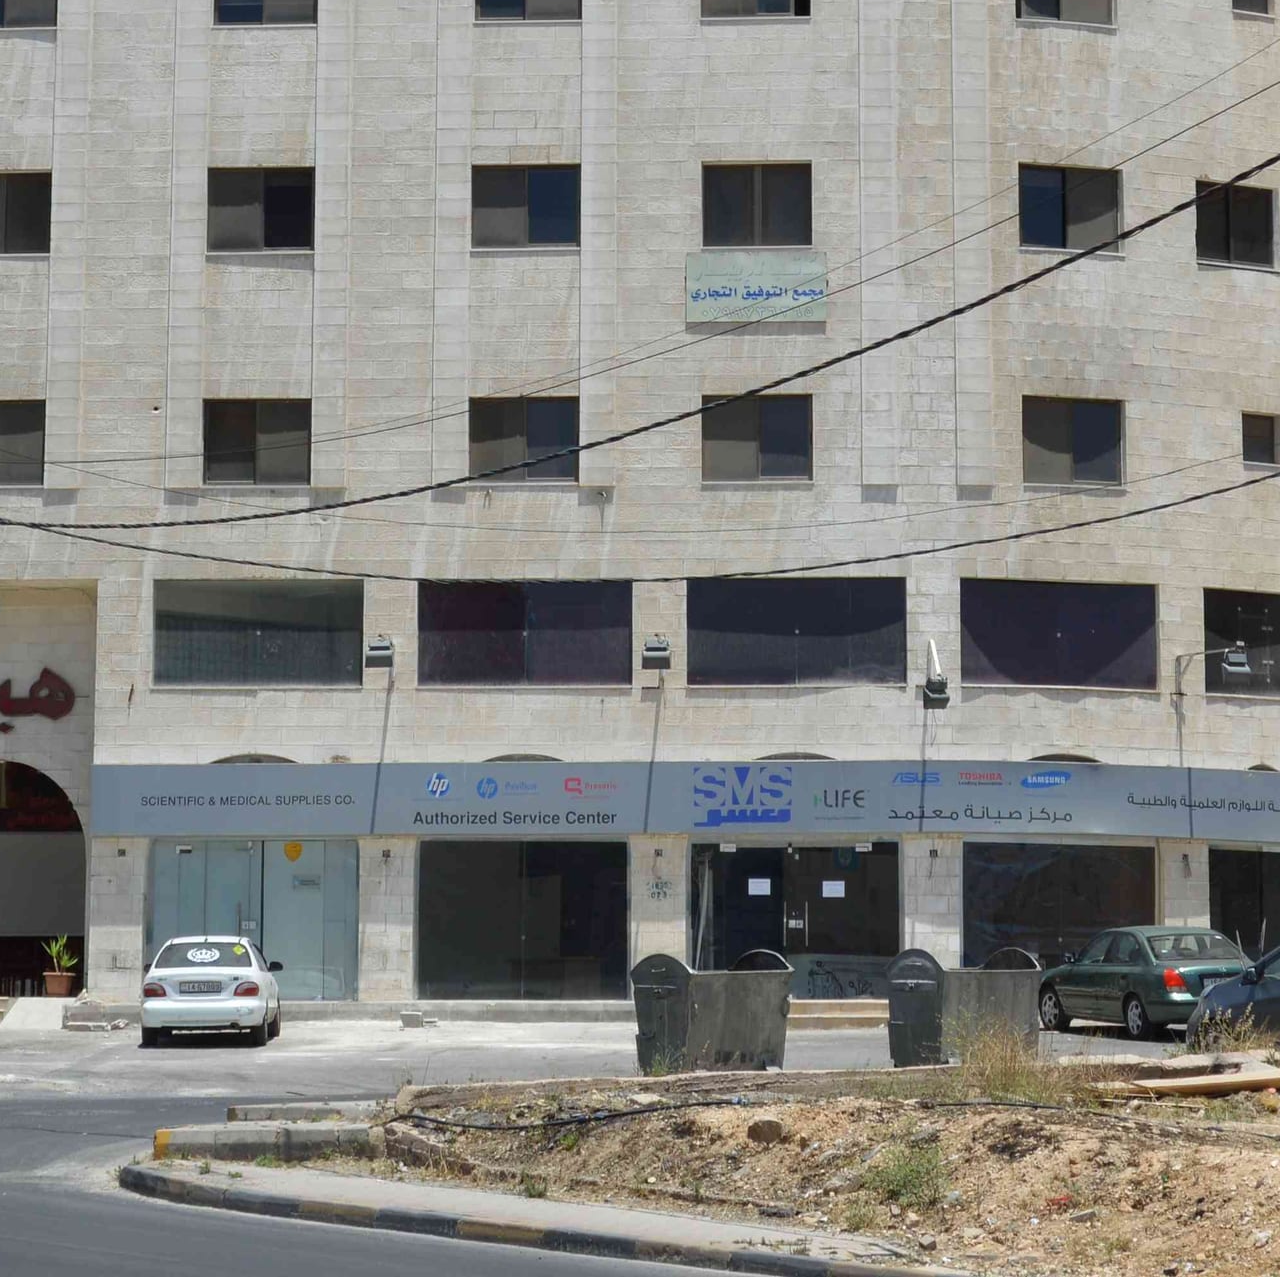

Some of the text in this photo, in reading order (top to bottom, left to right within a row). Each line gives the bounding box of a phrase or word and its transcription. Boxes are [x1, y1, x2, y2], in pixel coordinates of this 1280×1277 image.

[690, 285, 824, 302] مجمع التوفيق التجاري
[892, 771, 941, 784] ASUS
[959, 772, 1003, 781] TOSHIBA
[1026, 775, 1066, 785] SAMSUNG
[427, 772, 449, 799] hp
[693, 766, 793, 807] SMS
[140, 794, 356, 807] SCIENTIFIC & MEDICAL SUPPLIES CO.
[1127, 792, 1177, 809] والطبية
[1179, 794, 1226, 811] العلمية
[1227, 797, 1266, 813] اللوازم
[413, 811, 617, 825] Authorized Service Center
[888, 804, 1073, 824] مركز صيانة معتمد
